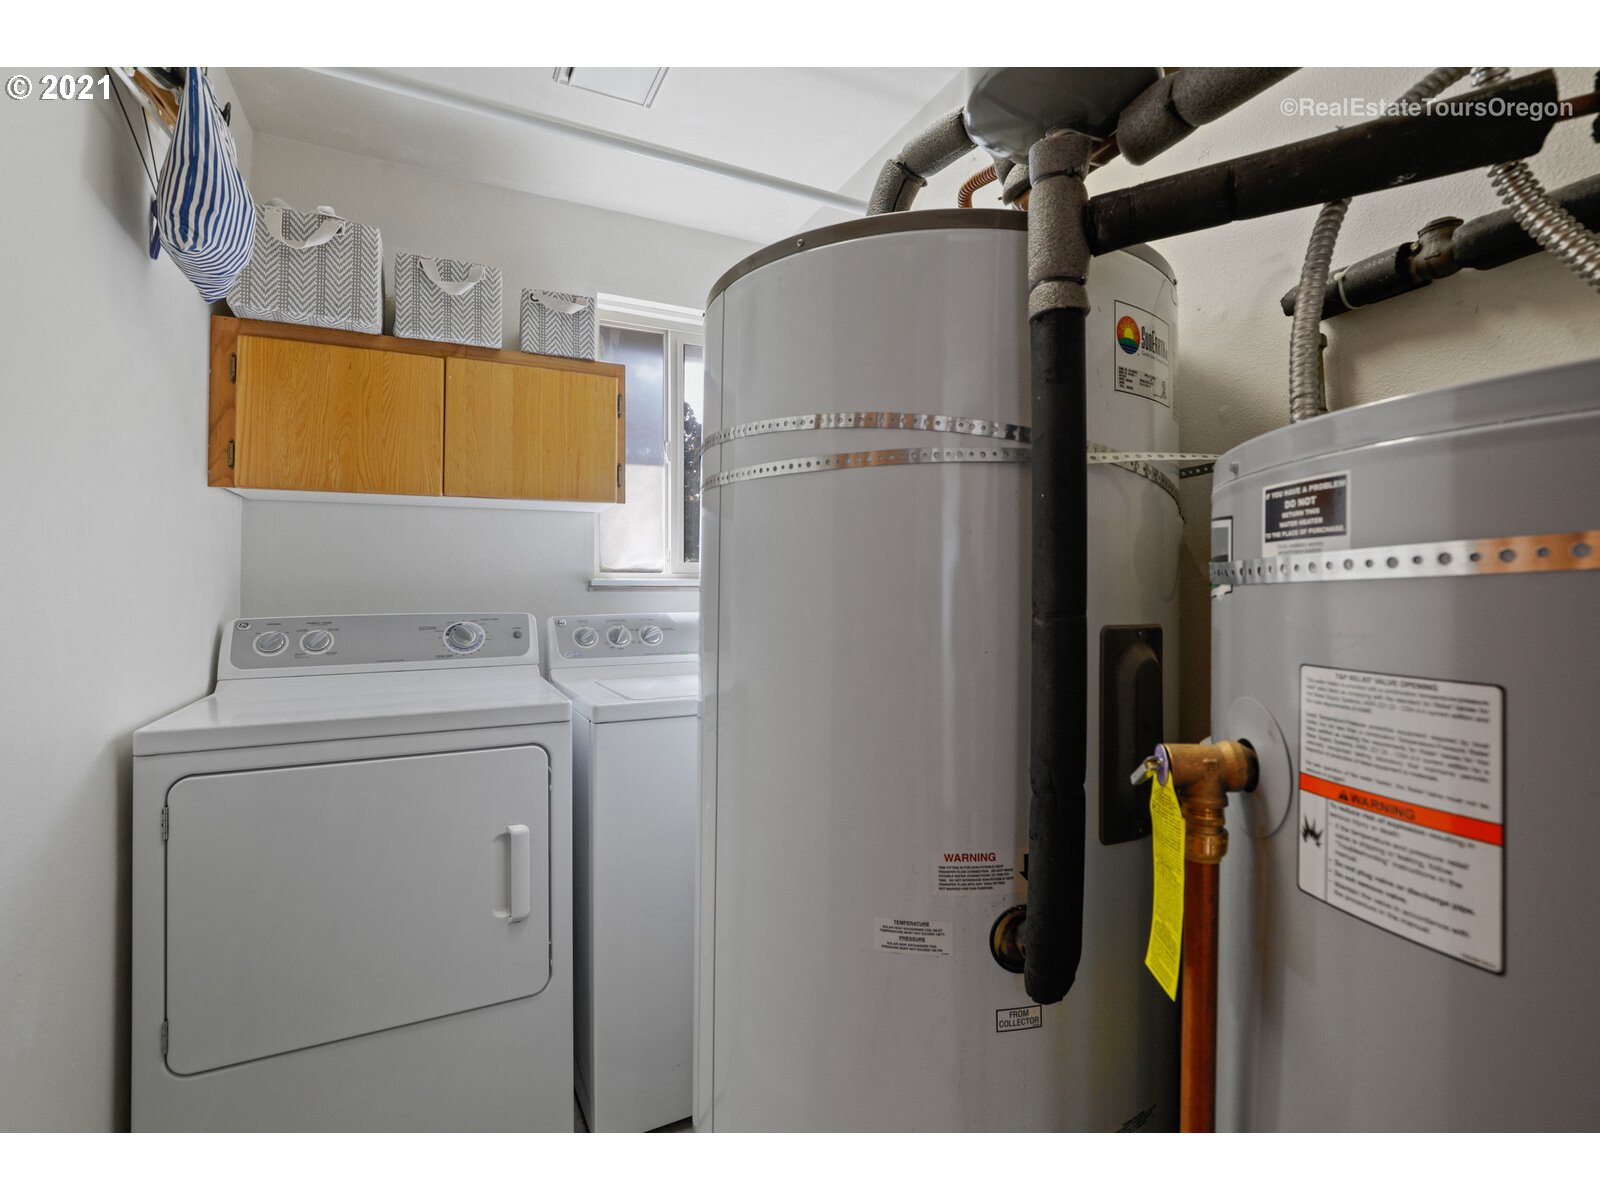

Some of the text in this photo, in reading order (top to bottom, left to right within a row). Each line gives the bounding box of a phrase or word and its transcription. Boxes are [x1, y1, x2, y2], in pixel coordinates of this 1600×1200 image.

[1272, 491, 1282, 499] YOU
[1284, 487, 1301, 496] HAVE
[1284, 496, 1317, 509] DO NOT
[1281, 507, 1321, 519] RETURN THIS
[1299, 517, 1323, 526] HEATER
[1282, 529, 1298, 537] PLACE
[1349, 791, 1416, 821] WARNING
[944, 852, 996, 863] WARNING
[1356, 868, 1372, 881] plug
[1374, 874, 1394, 888] valve
[1406, 885, 1450, 909] discharge
[899, 935, 926, 943] PRESSURE
[1009, 1009, 1029, 1018] FROM
[999, 1016, 1039, 1028] COLLECTOR
